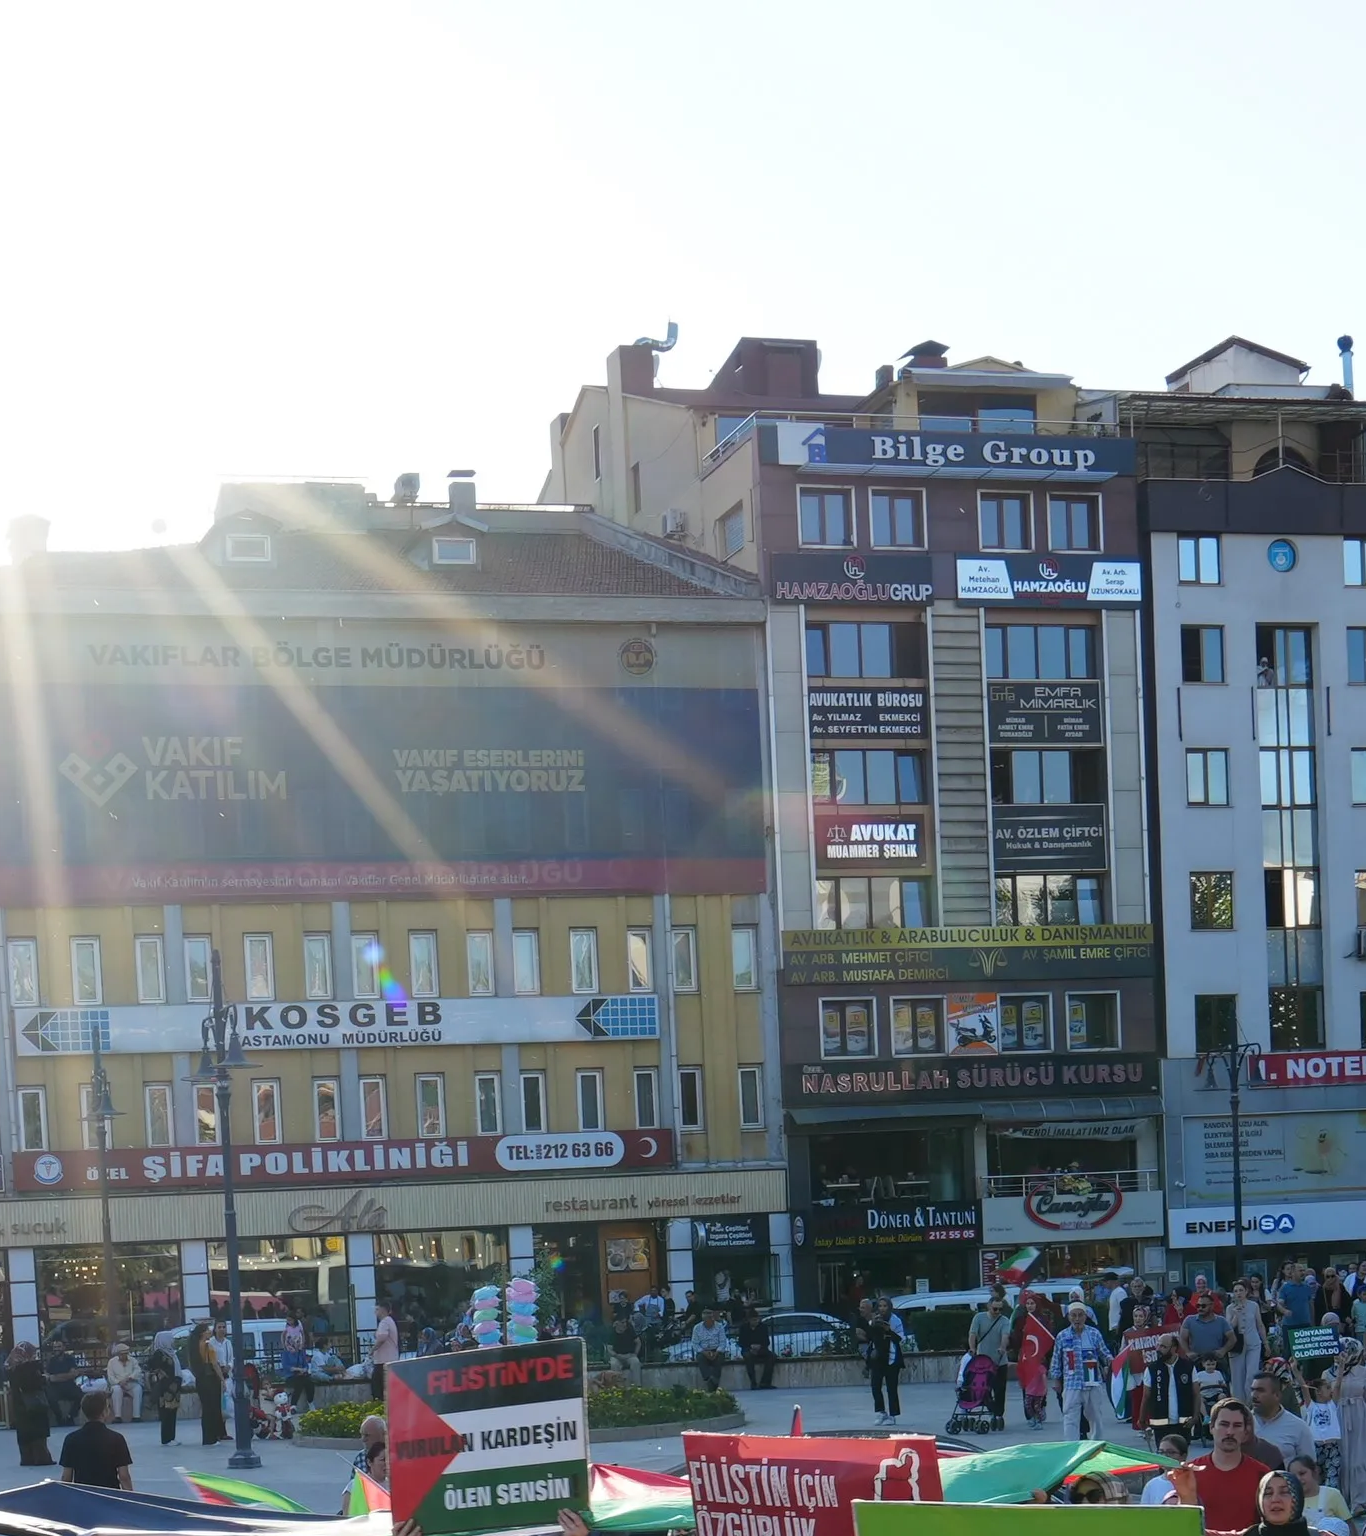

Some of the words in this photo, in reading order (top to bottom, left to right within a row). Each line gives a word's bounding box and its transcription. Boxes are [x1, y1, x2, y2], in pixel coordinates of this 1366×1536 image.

[871, 435, 965, 466] Bilge
[983, 440, 1096, 471] Group
[978, 565, 990, 573] Av.
[969, 575, 1000, 583] Metehan
[1013, 579, 1086, 593] HAMZAOĞLU
[961, 585, 1009, 594] HAMZAOĞLU
[89, 644, 239, 668] VAKIFLAR
[253, 641, 351, 668] BÖLGE
[362, 642, 545, 670] MÜDÜRLÜĞÜ
[809, 693, 872, 707] AVUKATLIK
[877, 691, 923, 707] BÜROSU
[1034, 687, 1081, 697] EMFA
[1020, 698, 1097, 709] MİMARLIK
[812, 713, 825, 721] Av.
[827, 713, 862, 721] YILMAZ
[828, 724, 877, 734] SEYFETTİN
[142, 736, 243, 767] VAKIF
[393, 749, 458, 767] VAKIF
[464, 748, 585, 767] ESERLERİNİ
[145, 770, 287, 800] KATILIM
[396, 769, 586, 795] YAŞATIYORUZ
[850, 824, 916, 841] AVUKAT
[995, 828, 1014, 839] AV.
[1018, 826, 1059, 838] ÖZLEM
[827, 845, 879, 858] MUAMMER
[883, 843, 918, 859] ŞENLİK
[1034, 841, 1040, 849] &
[1042, 840, 1093, 850] Danışmanlık
[389, 874, 421, 885] Genel
[791, 932, 874, 946] AVUKATLIK
[881, 931, 891, 944] &
[898, 928, 1019, 943] ARABULUCULUK
[1025, 928, 1035, 942] &
[1041, 926, 1147, 944] DANIŞMANLIK
[790, 954, 806, 965] AV.
[812, 953, 837, 965] ARB.
[842, 952, 891, 964] MEHMET
[1043, 946, 1077, 962] ŞAMİL
[1081, 948, 1111, 959] EMRE
[812, 971, 838, 983] ARB.
[843, 969, 895, 981] MUSTAFA
[899, 967, 949, 981] DEMİRCİ
[244, 1001, 442, 1031] KOSGEB
[241, 1032, 329, 1047] ASTAMONU
[342, 1028, 442, 1046] MÜDÜRLÜĞÜ
[802, 1069, 949, 1094] NASRULLAH
[956, 1061, 1055, 1089] SÜRÜCÜ
[1062, 1063, 1143, 1085] KURSU
[507, 1145, 534, 1161] TEL:
[544, 1144, 568, 1159] 212
[574, 1143, 590, 1158] 63
[594, 1142, 614, 1157] 66
[143, 1151, 226, 1183] ŞİFA
[239, 1140, 469, 1176] POLİKLİNİĞİ
[545, 1194, 638, 1213] restaurant
[647, 1195, 688, 1210] yöresel
[867, 1209, 911, 1229] DÖNER
[915, 1206, 925, 1227] &
[11, 1217, 67, 1236] sucuk
[929, 1231, 946, 1240] 212
[949, 1230, 961, 1239] 55
[963, 1229, 975, 1239] 05
[1294, 1328, 1333, 1337] DÜNYANIN
[1294, 1347, 1339, 1358] ÖLDÜRÜLDÜ
[427, 1354, 574, 1396] FİLİSTİN'DE
[397, 1432, 473, 1461] VURULAN
[481, 1416, 577, 1450] KARDEŞİN
[689, 1455, 790, 1508] FİLİSTİN
[793, 1468, 839, 1513] İÇİN
[443, 1483, 492, 1510] ÖLEN
